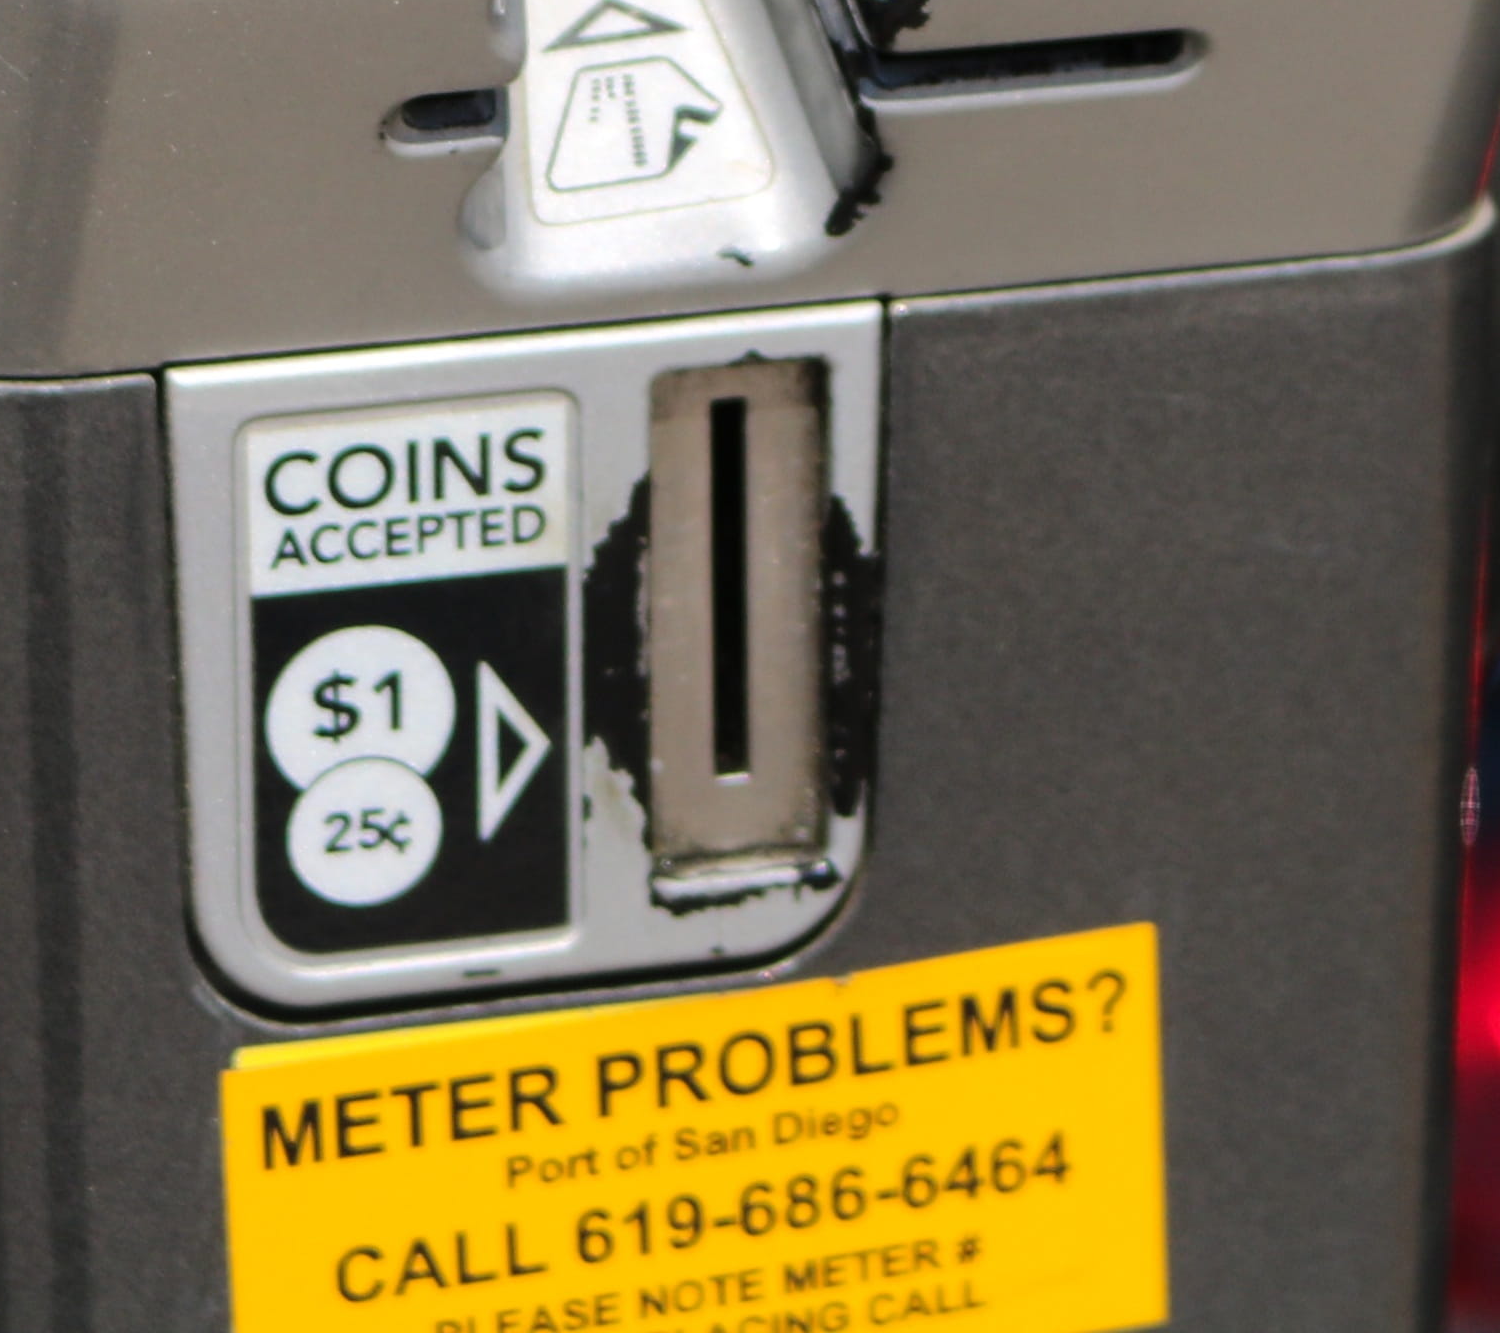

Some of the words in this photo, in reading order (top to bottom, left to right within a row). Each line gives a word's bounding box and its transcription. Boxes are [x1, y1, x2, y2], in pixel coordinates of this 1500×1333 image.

[264, 429, 545, 516] COINS
[271, 504, 548, 570] ACCEPTED
[312, 669, 405, 745] $1
[324, 809, 413, 855] 25¢
[261, 1065, 564, 1171] METER
[597, 970, 1129, 1119] PROBLEMS?
[506, 1148, 600, 1189] Port
[616, 1137, 660, 1171] of
[675, 1123, 757, 1161] San
[773, 1098, 900, 1144] Diego
[337, 1223, 548, 1303] CALL
[577, 1133, 1071, 1264] 619-686-6464
[640, 1268, 763, 1318] NOTE
[784, 1237, 940, 1293] METER
[956, 1235, 983, 1264] #
[867, 1281, 987, 1327] CALL
